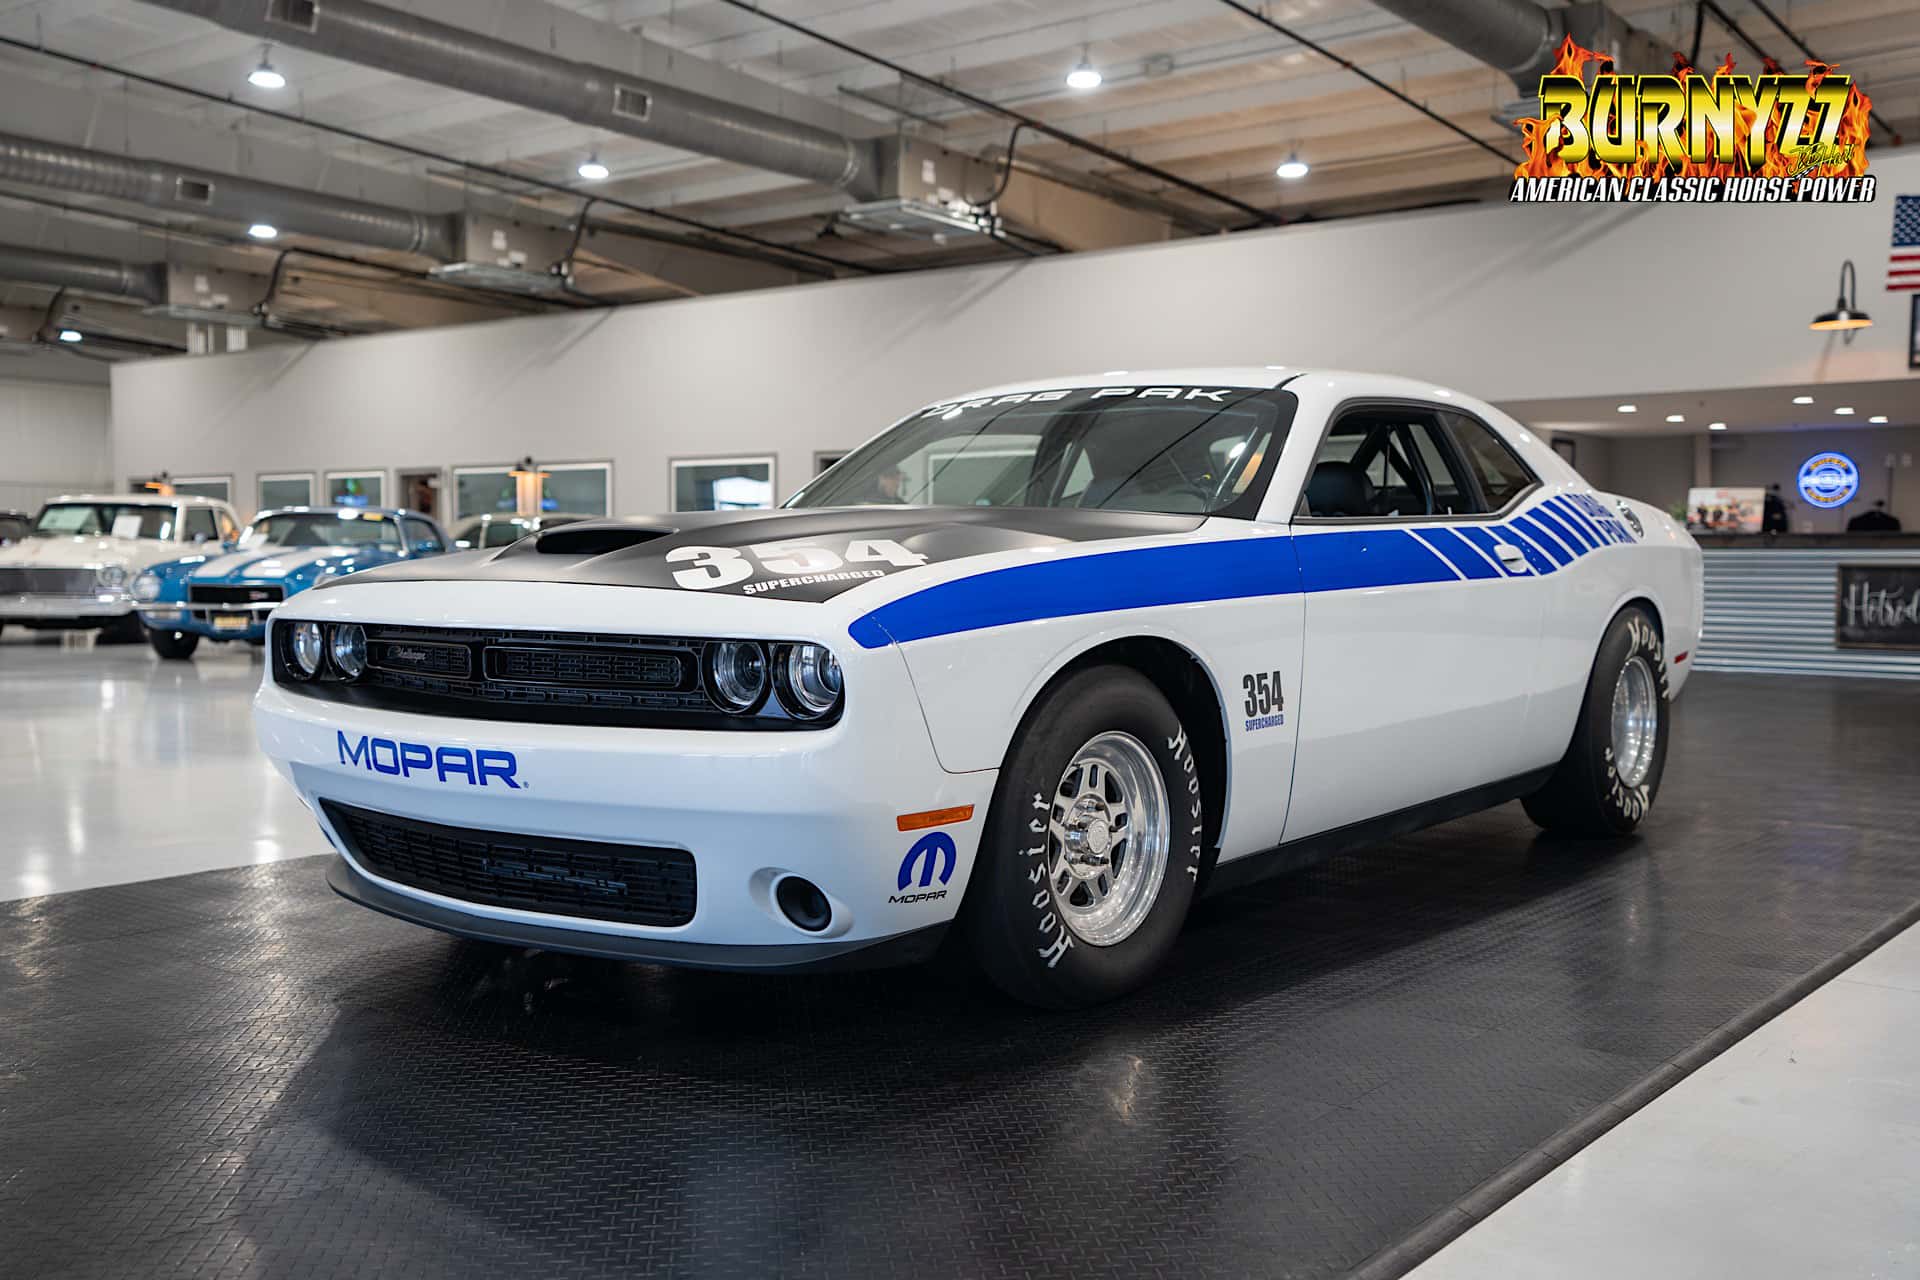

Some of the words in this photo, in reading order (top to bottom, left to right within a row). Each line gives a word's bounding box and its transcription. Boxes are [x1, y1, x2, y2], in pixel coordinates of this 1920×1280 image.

[1090, 387, 1233, 402] PAK
[665, 539, 929, 591] 354
[743, 570, 886, 596] SUPERCHARGED
[1242, 670, 1285, 718] 354
[337, 729, 521, 789] MOPAR
[887, 890, 948, 904] MOPAR
[1018, 792, 1075, 968] Hoosier
